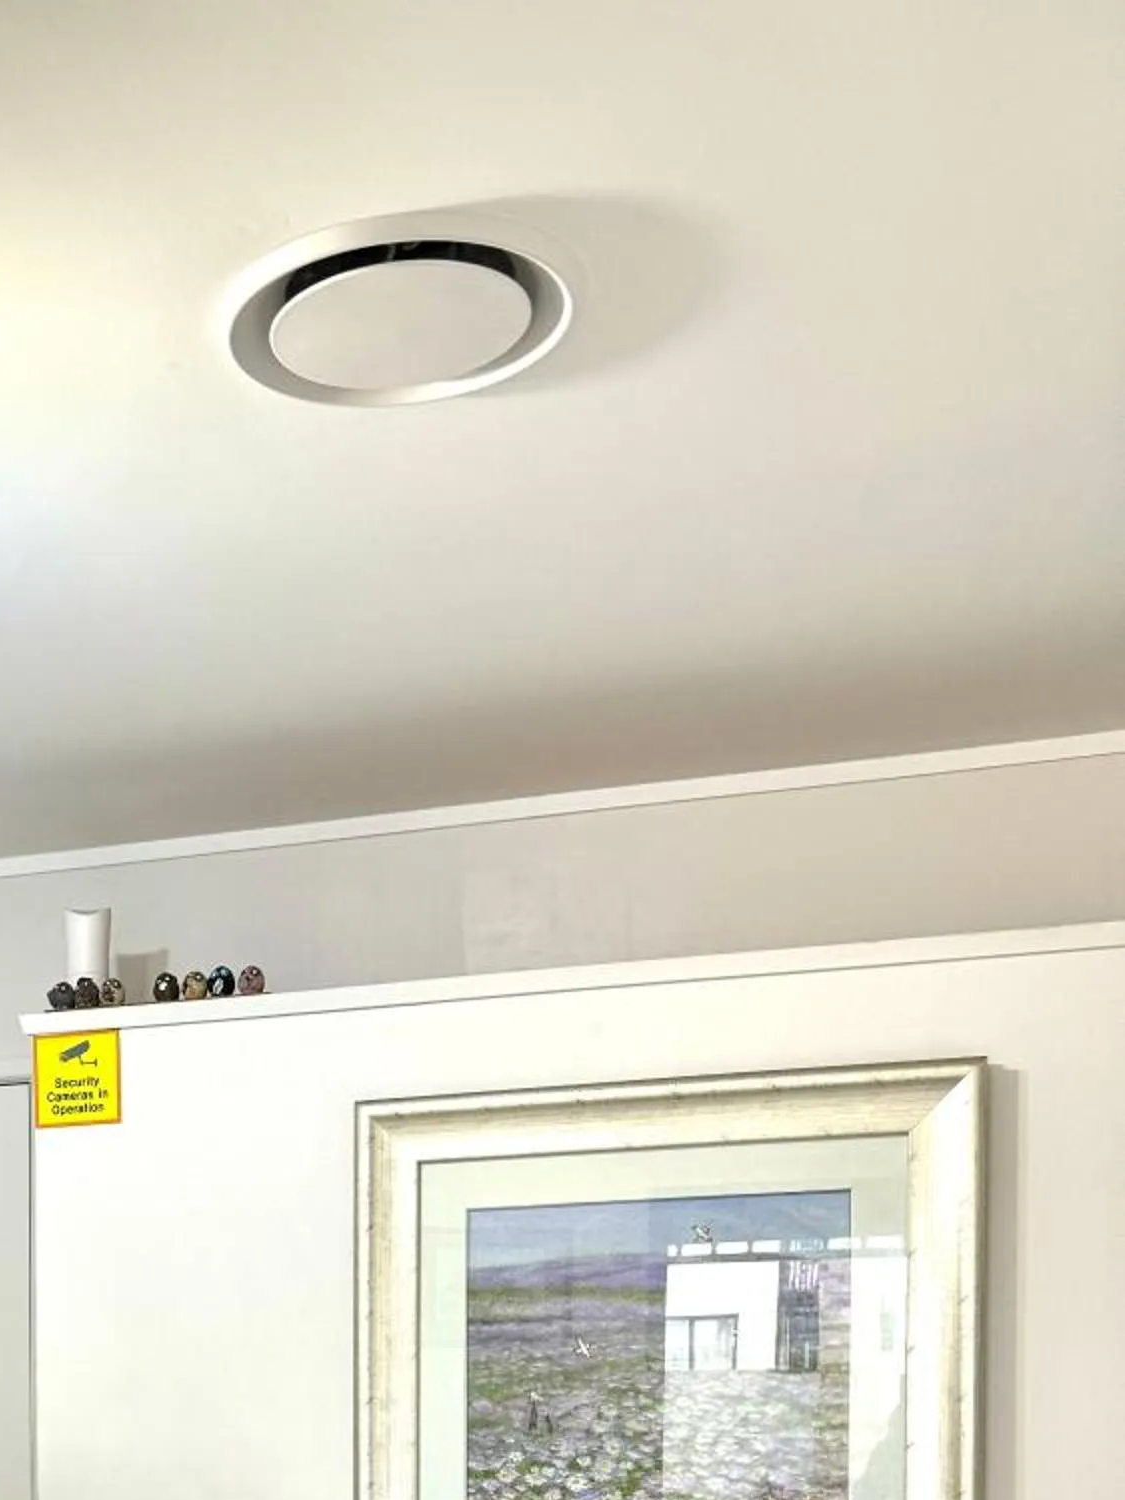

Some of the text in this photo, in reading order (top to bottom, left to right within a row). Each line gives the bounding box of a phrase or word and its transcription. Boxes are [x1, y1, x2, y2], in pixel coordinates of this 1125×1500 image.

[54, 1076, 100, 1089] Security
[46, 1087, 110, 1103] Cameras in
[51, 1103, 106, 1116] Operation
